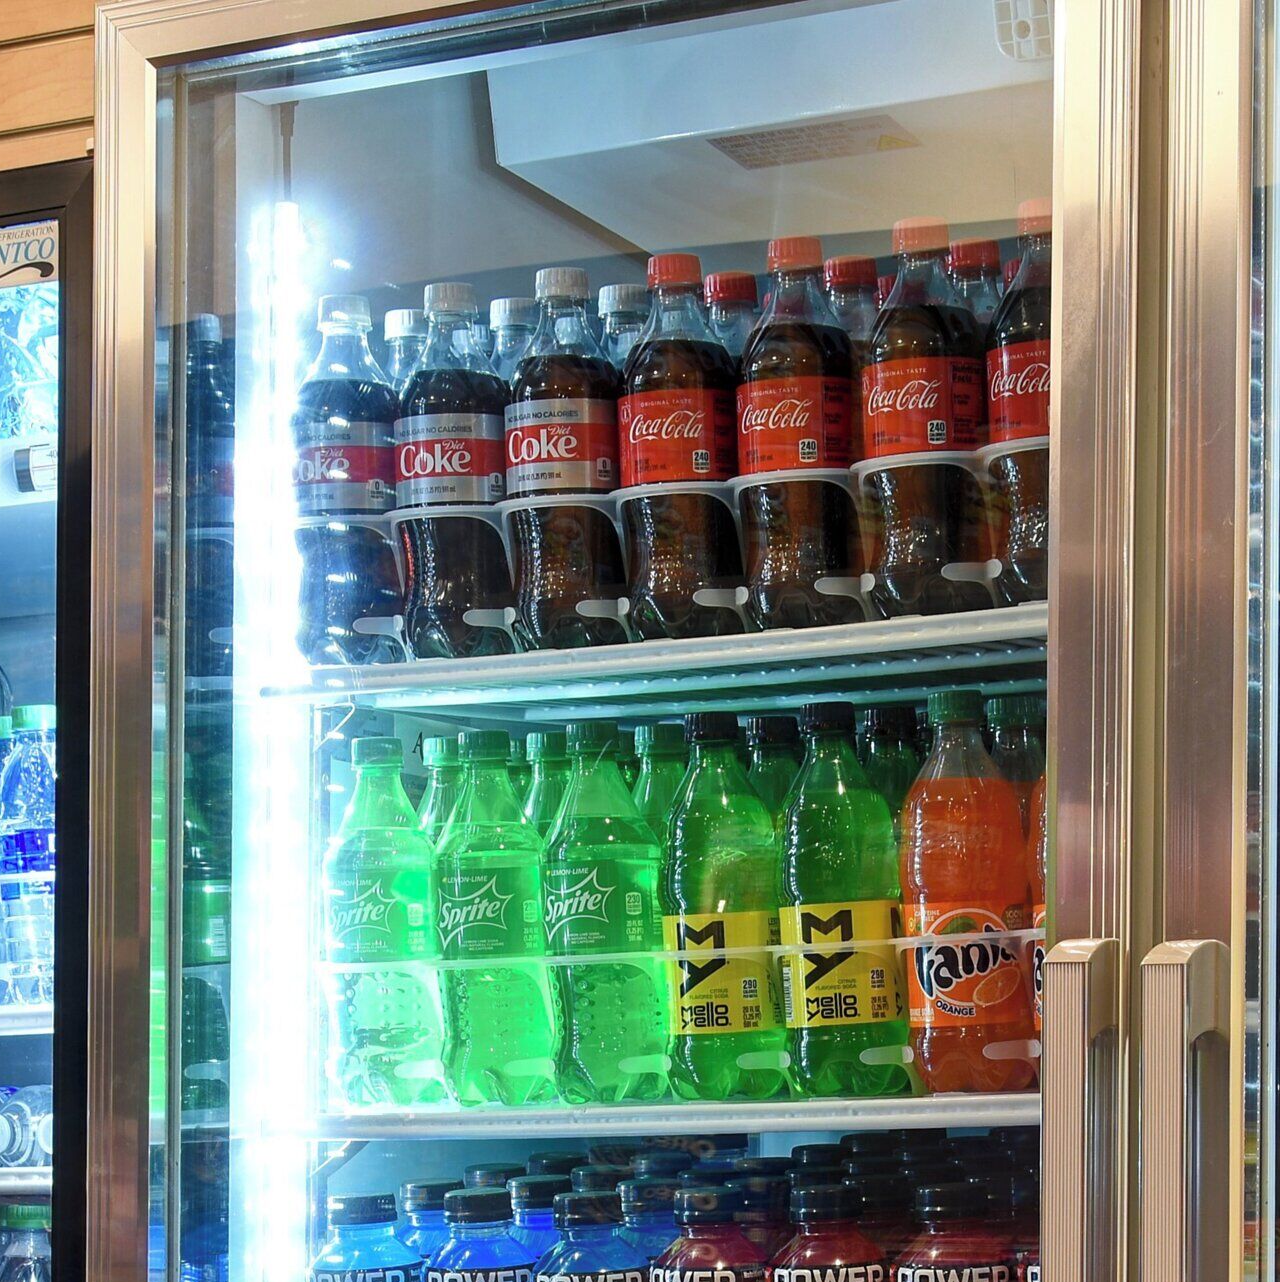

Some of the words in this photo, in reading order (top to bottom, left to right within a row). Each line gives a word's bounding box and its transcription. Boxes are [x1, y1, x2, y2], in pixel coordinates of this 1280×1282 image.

[751, 388, 776, 397] ORIGINAL
[868, 379, 942, 416] Coca-Cola
[544, 410, 578, 418] CALORIES
[742, 399, 813, 433] Coca-Cola
[548, 426, 571, 436] Diet
[929, 422, 945, 432] 240
[443, 441, 464, 451] Diet
[509, 431, 577, 462] Coke
[801, 441, 816, 451] 240
[400, 443, 471, 477] Coke
[551, 868, 588, 877] LEMON-LIME
[448, 876, 488, 884] LEMON-LIME
[545, 892, 601, 923] Sprite
[329, 899, 385, 932] Sprite
[440, 899, 500, 930] Sprite
[871, 970, 884, 979] 290
[743, 980, 757, 989] 290
[936, 1000, 976, 1016] ORANGE
